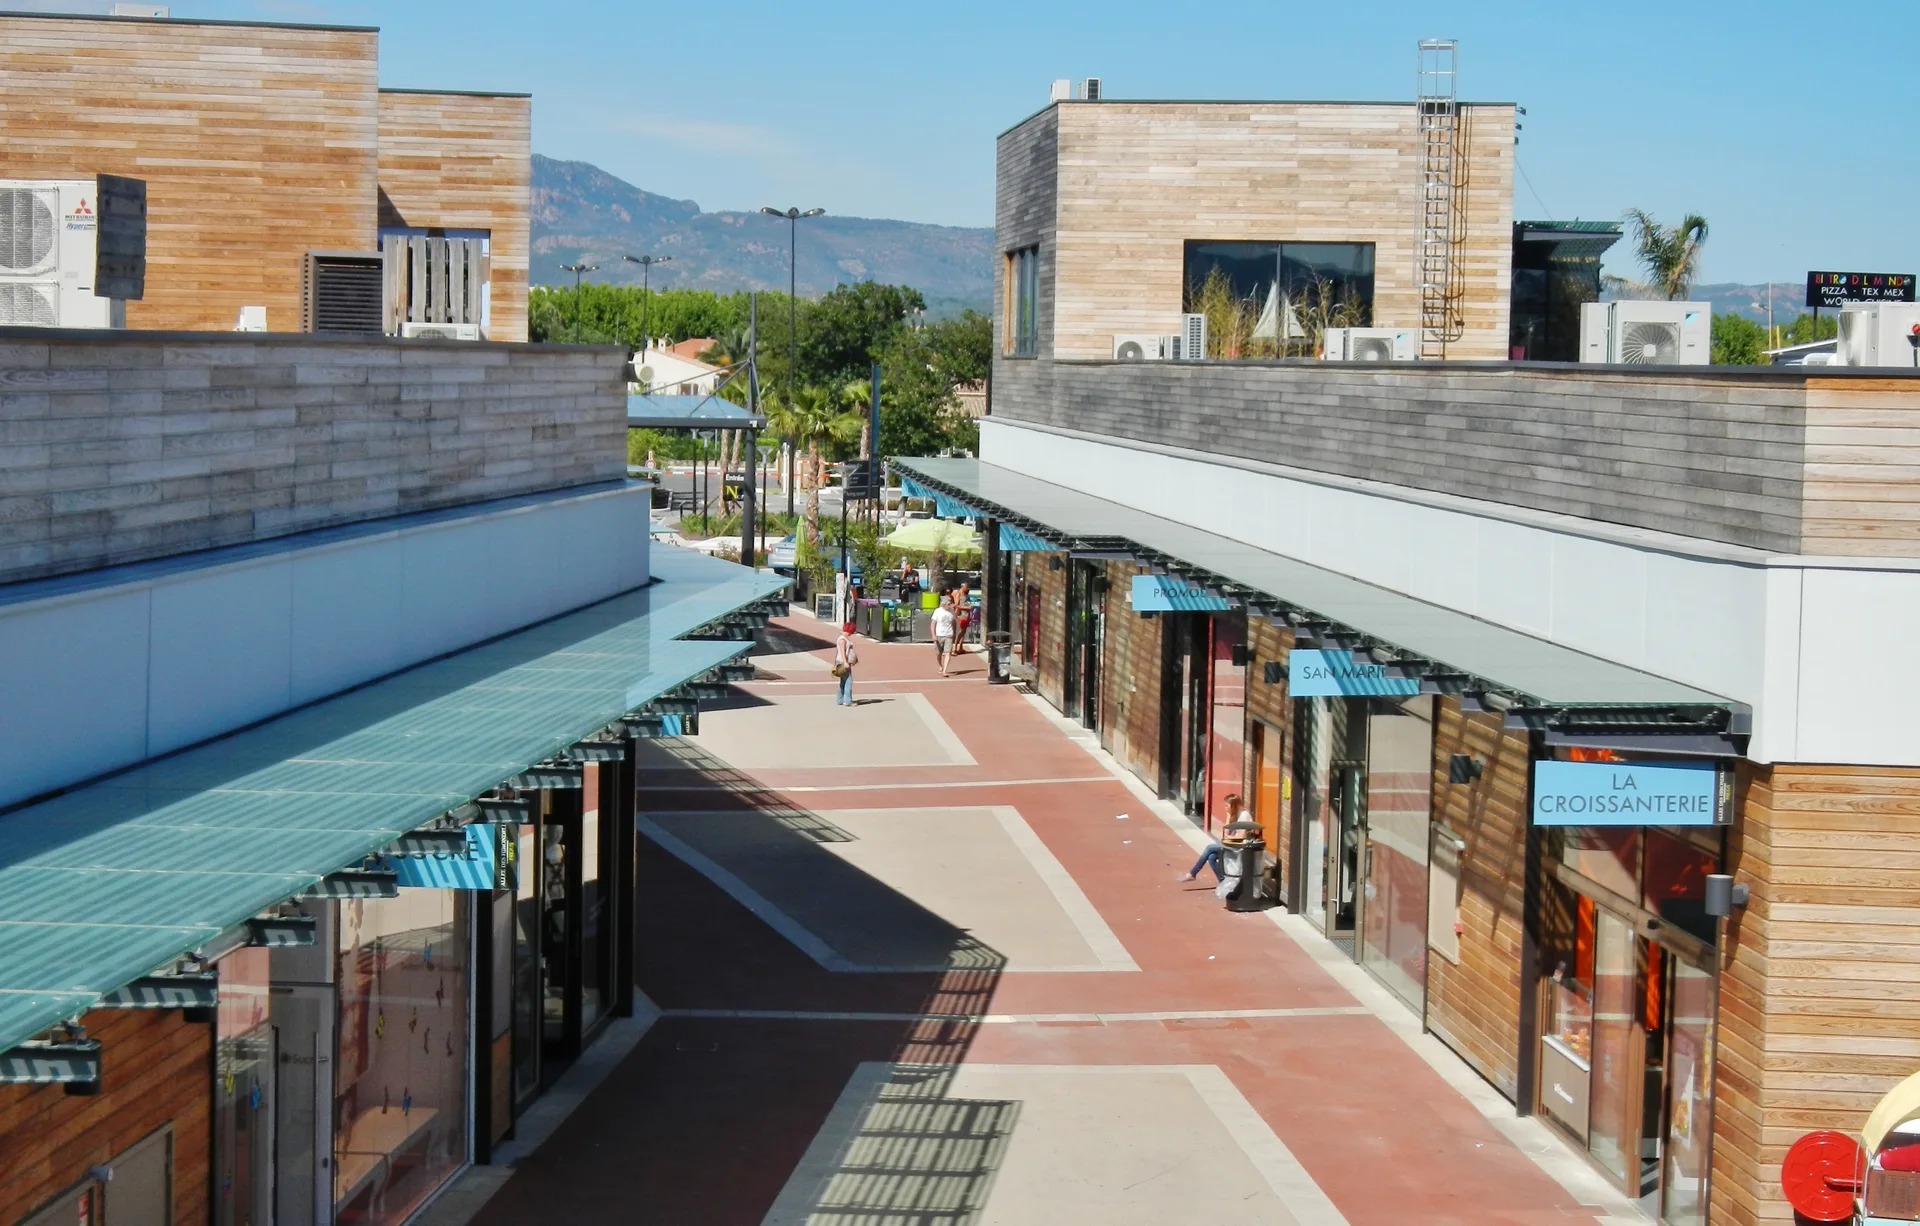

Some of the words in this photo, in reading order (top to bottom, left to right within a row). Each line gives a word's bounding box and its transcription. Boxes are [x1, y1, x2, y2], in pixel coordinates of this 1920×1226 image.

[1821, 286, 1848, 295] PIZZA
[1862, 287, 1879, 296] TEX
[1883, 288, 1904, 297] MEX
[725, 473, 745, 482] Entrée
[1303, 665, 1336, 680] SAN
[1612, 773, 1638, 791] LA
[1538, 794, 1709, 814] CROISSANTERIE
